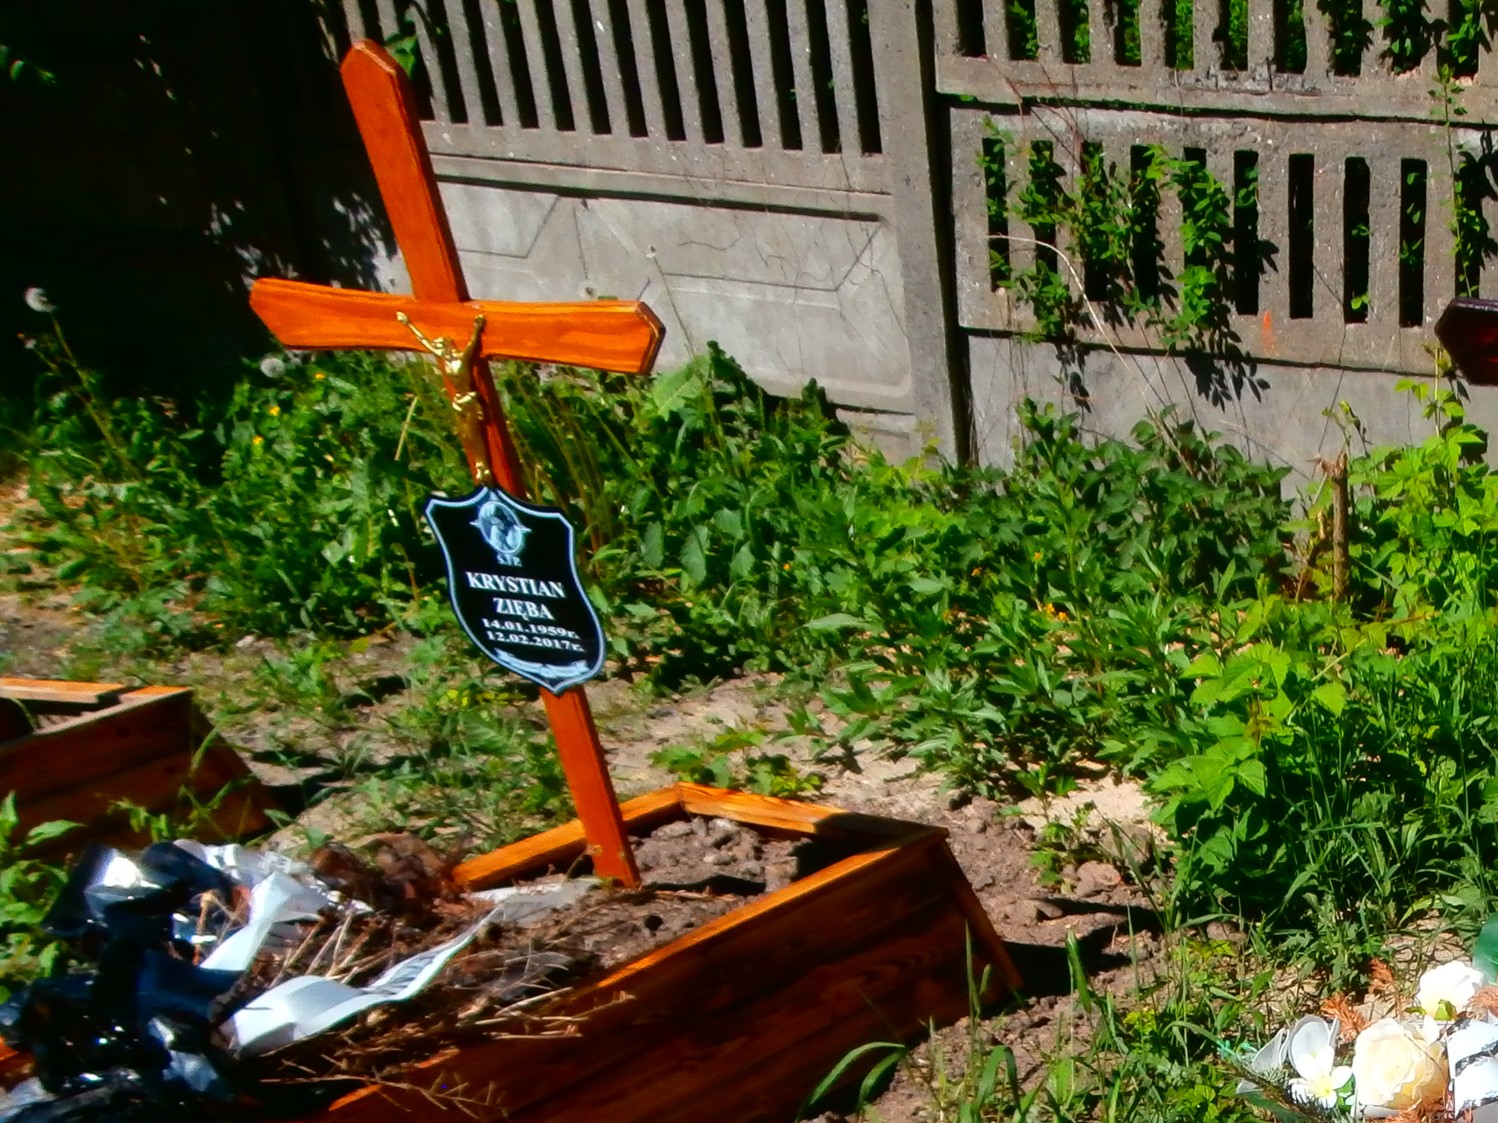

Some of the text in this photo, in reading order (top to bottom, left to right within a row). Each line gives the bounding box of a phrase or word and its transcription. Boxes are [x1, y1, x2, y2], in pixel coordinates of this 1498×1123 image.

[465, 571, 566, 598] KRYSTIAN
[492, 598, 556, 621] ZIĘBA
[481, 618, 581, 640] 14.01.1959r.
[485, 630, 585, 652] 12.02.2017r.
